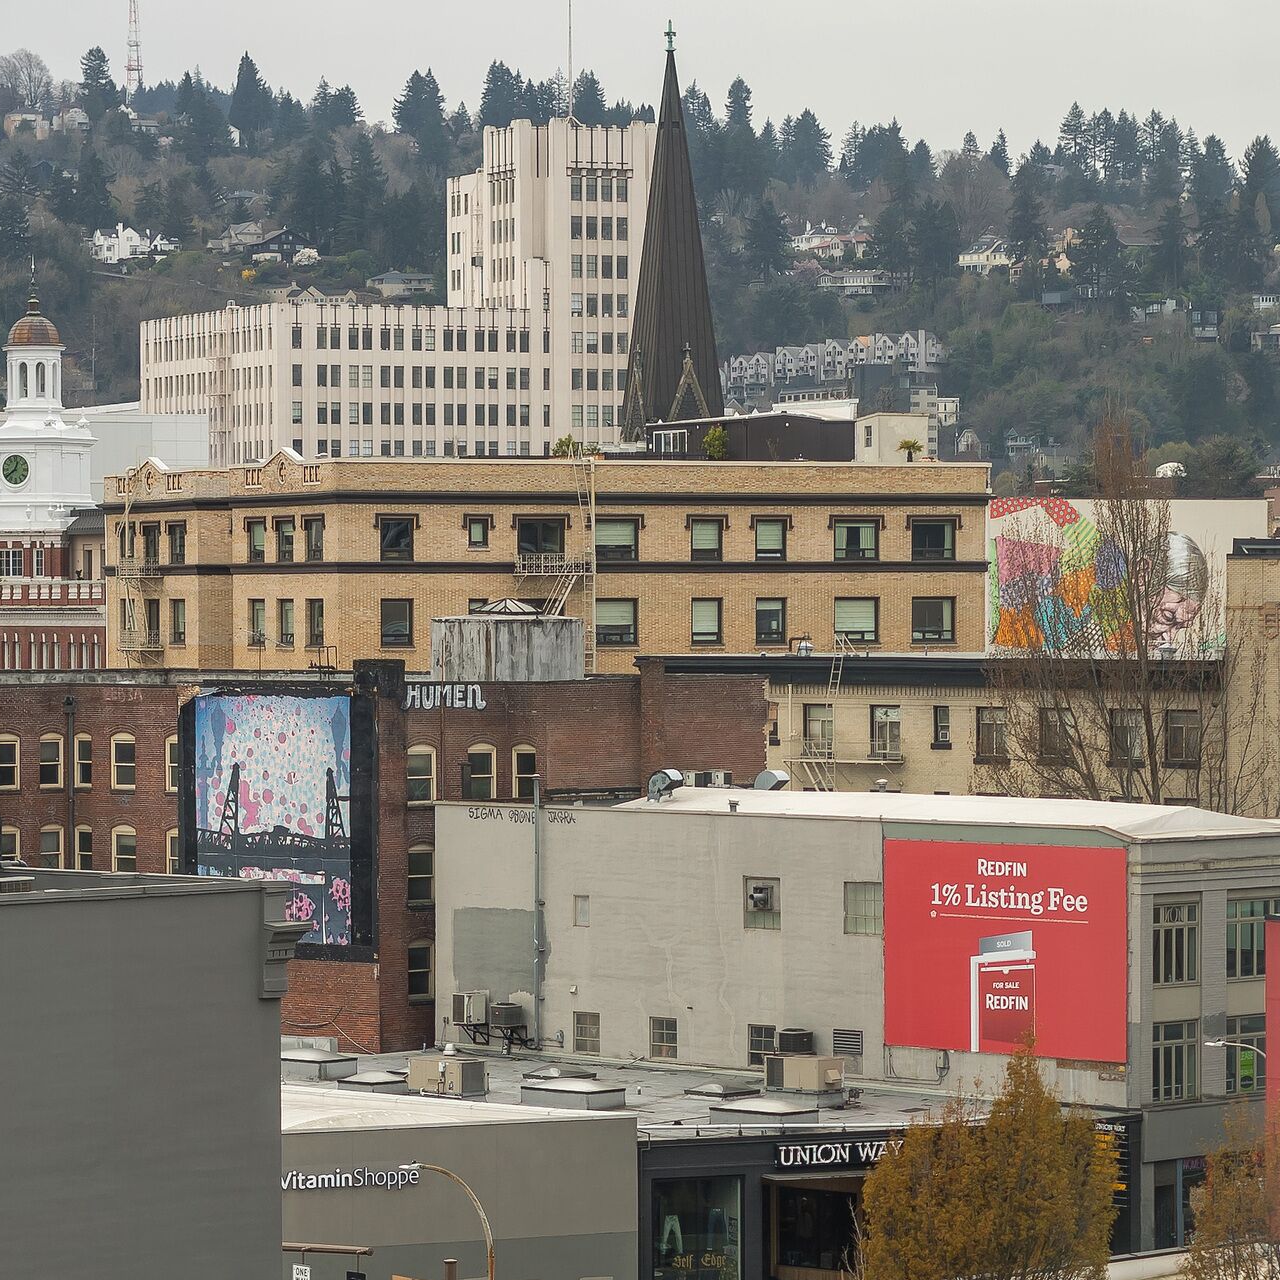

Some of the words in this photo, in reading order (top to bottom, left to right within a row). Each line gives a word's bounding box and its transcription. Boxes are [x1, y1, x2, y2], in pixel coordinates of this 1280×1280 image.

[401, 684, 487, 710] HUMEN
[468, 807, 504, 820] SIGMA
[977, 859, 1027, 877] REDFIN
[931, 883, 961, 906] 1%
[965, 884, 1044, 915] Listing
[1047, 888, 1088, 912] Fee
[996, 940, 1012, 948] SOLD
[985, 993, 1028, 1011] REDFIN
[778, 1143, 852, 1166] UNION
[855, 1140, 904, 1163] WAY
[281, 1167, 419, 1190] VitaminShoppe
[701, 1253, 726, 1268] Edge
[295, 1267, 308, 1277] ONE
